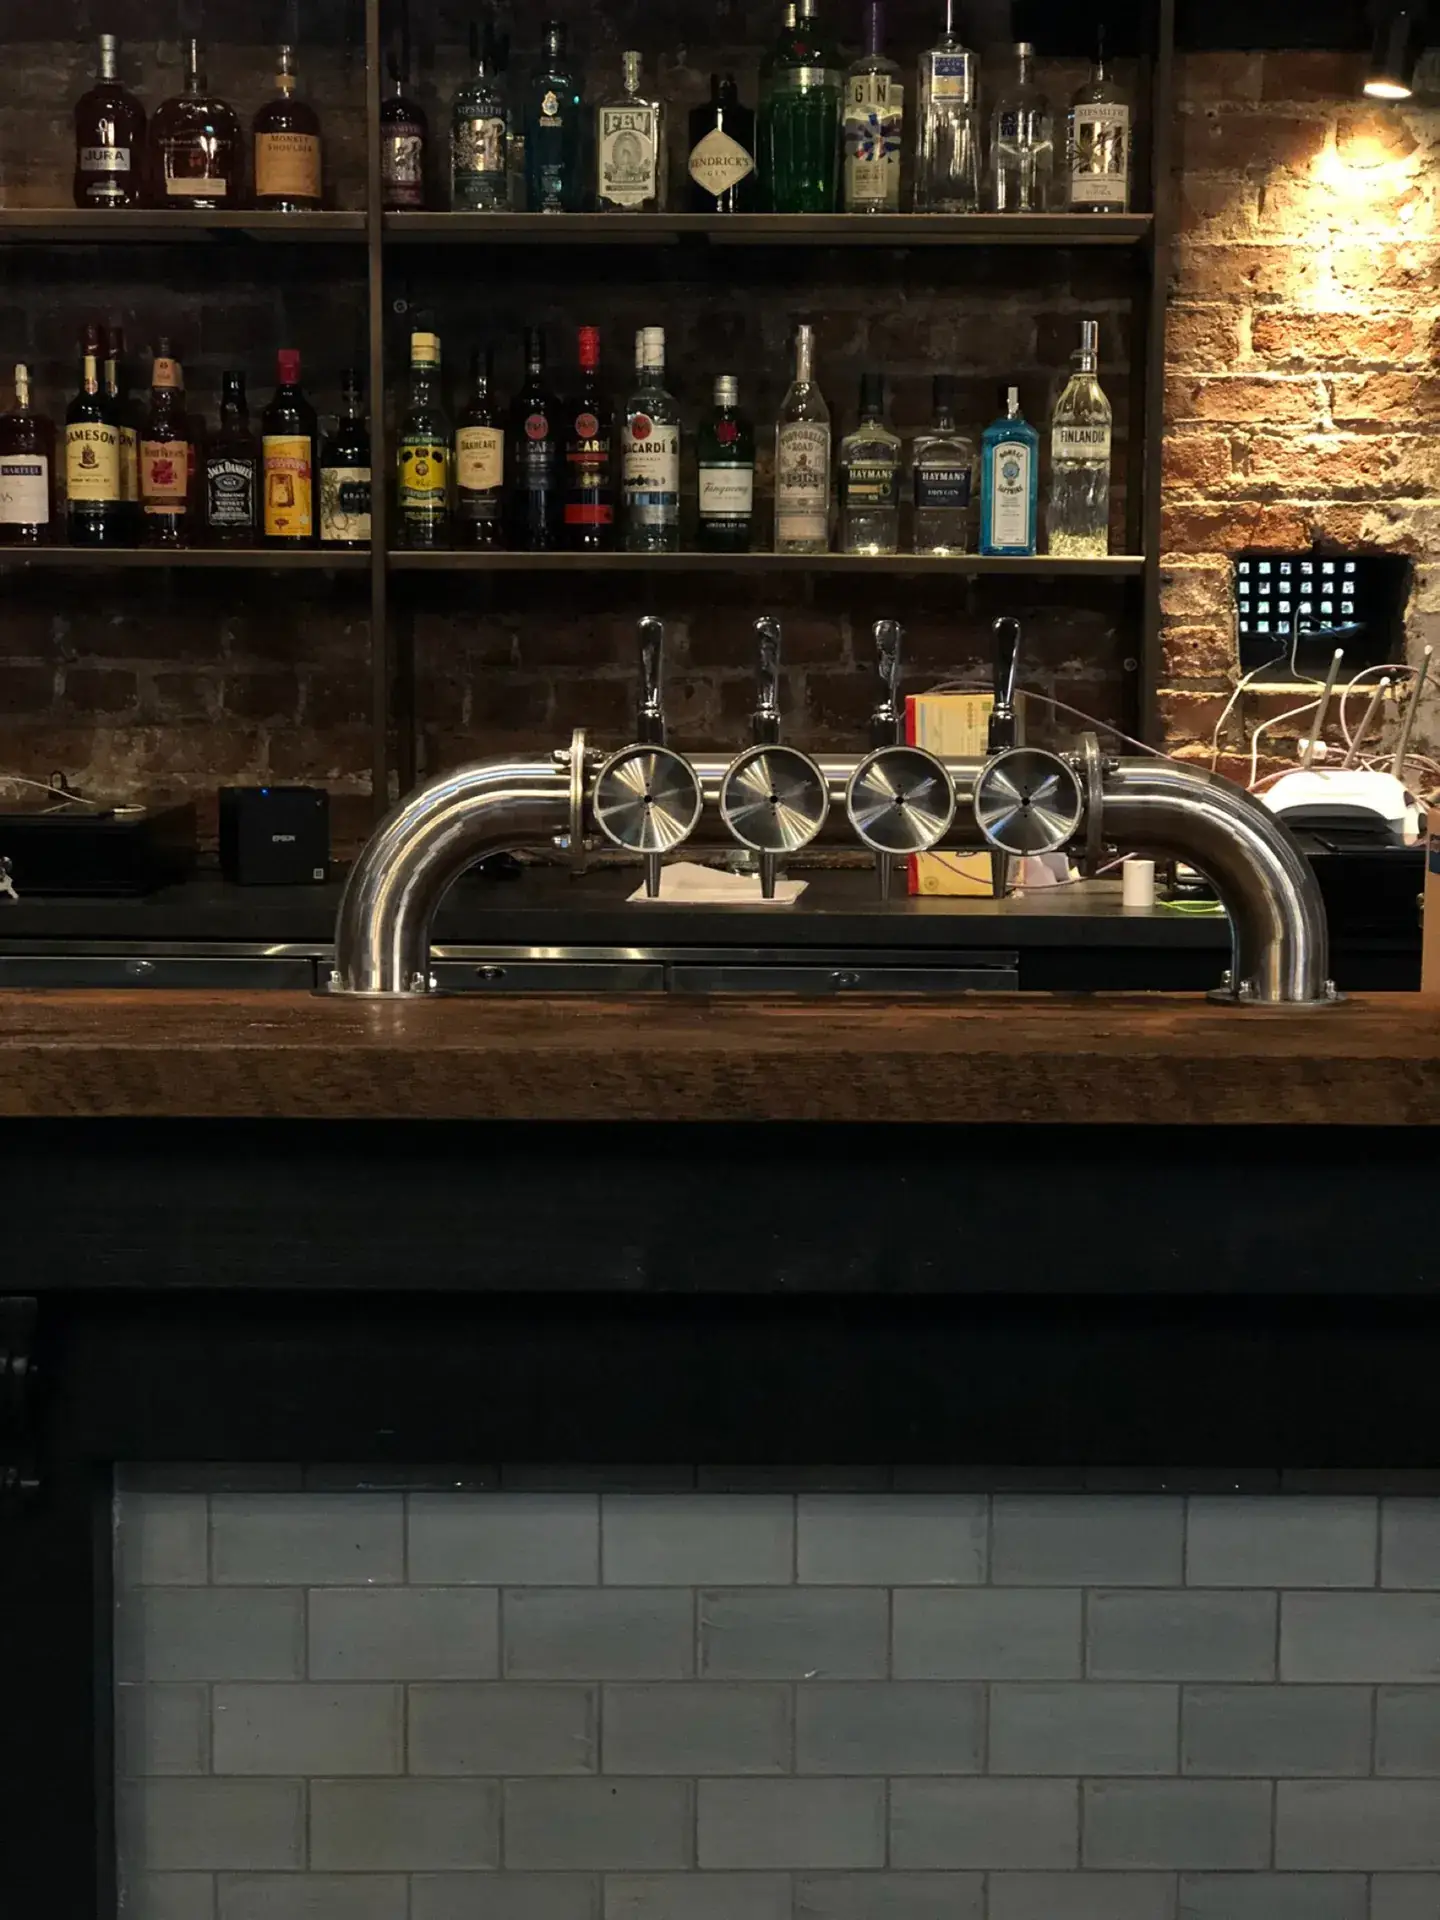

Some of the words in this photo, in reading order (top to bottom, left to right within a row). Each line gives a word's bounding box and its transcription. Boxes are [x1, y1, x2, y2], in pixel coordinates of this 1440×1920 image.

[855, 84, 886, 102] GIN
[606, 112, 649, 133] FEW
[84, 150, 125, 162] JURA
[691, 156, 749, 169] HENDRICK'S
[66, 429, 116, 446] JAMESON
[1060, 430, 1105, 443] FINLANDIA
